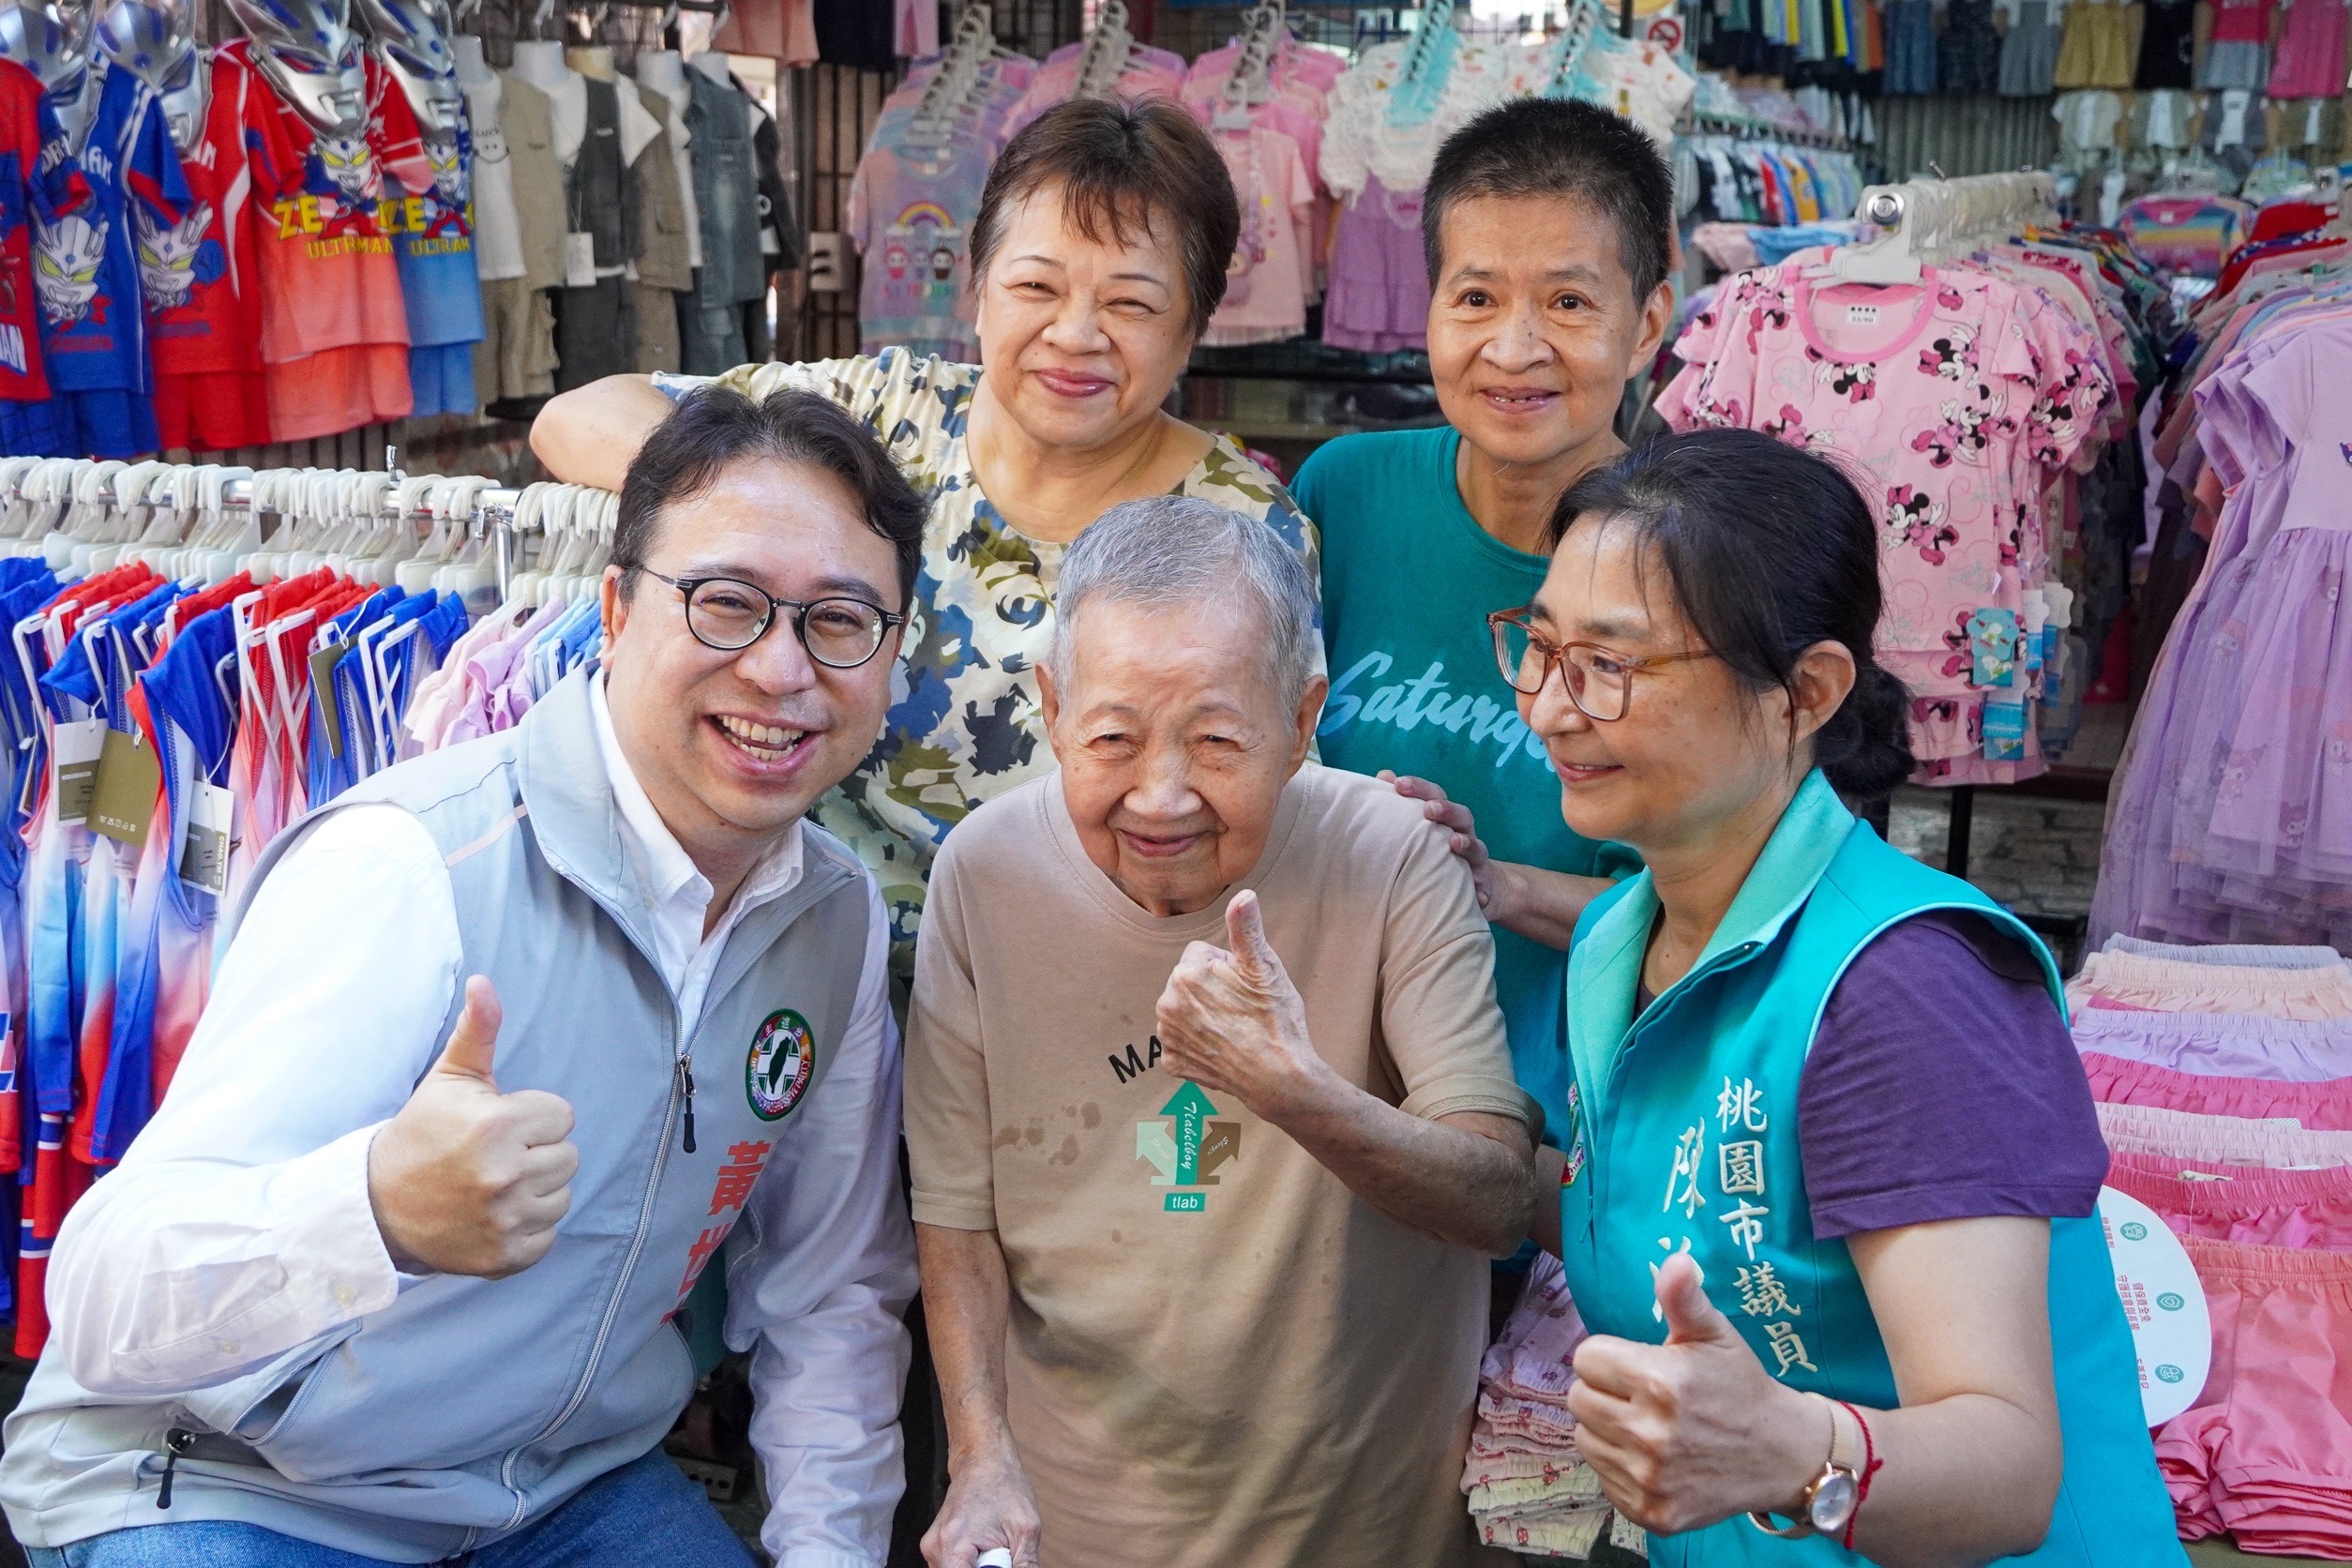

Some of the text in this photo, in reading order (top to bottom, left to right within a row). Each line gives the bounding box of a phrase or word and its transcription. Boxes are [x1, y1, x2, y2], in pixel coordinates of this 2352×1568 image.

[1317, 651, 1555, 773] Satur
[659, 1140, 771, 1325] 黃世
[1172, 1196, 1199, 1209] tlab
[1715, 1075, 1818, 1378] 桃園市議員
